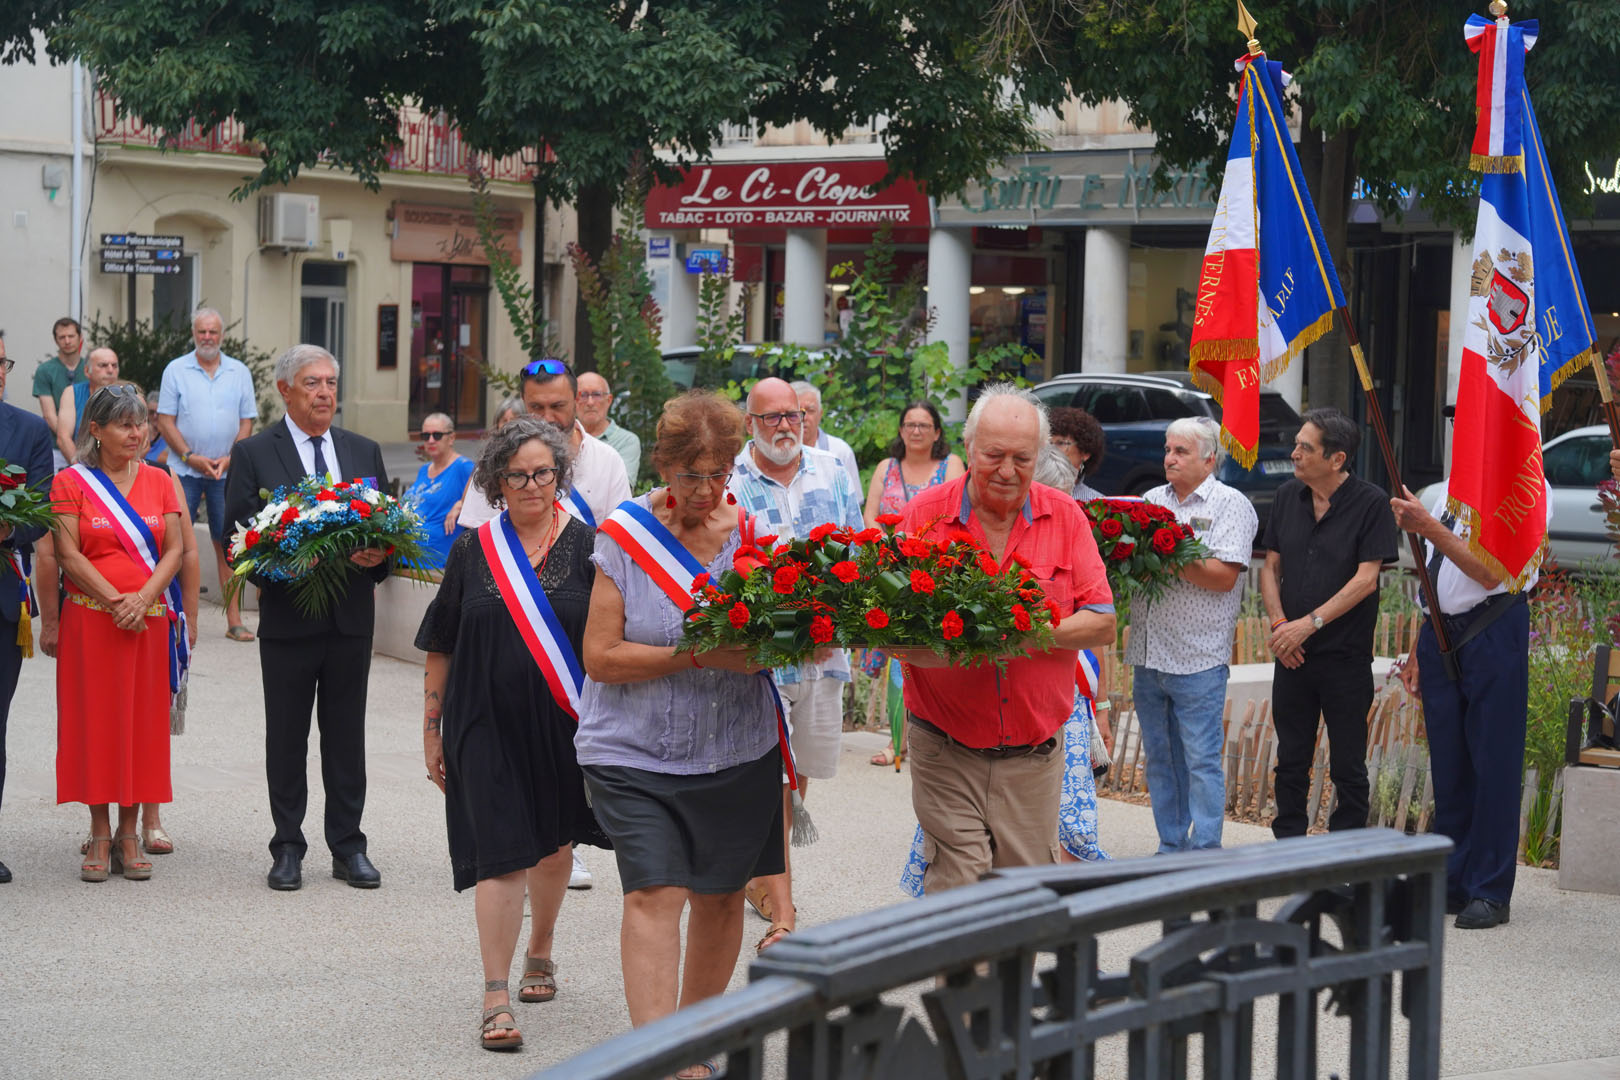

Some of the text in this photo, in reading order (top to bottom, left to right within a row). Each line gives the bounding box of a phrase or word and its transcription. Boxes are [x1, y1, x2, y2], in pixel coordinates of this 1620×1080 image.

[680, 168, 732, 204] Le
[659, 211, 704, 224] TABAC
[715, 211, 754, 224] LOTO
[764, 210, 815, 224] BAZAR
[826, 209, 911, 223] JOURNAUX
[134, 249, 150, 259] Ville
[1494, 442, 1545, 536] FRONT
